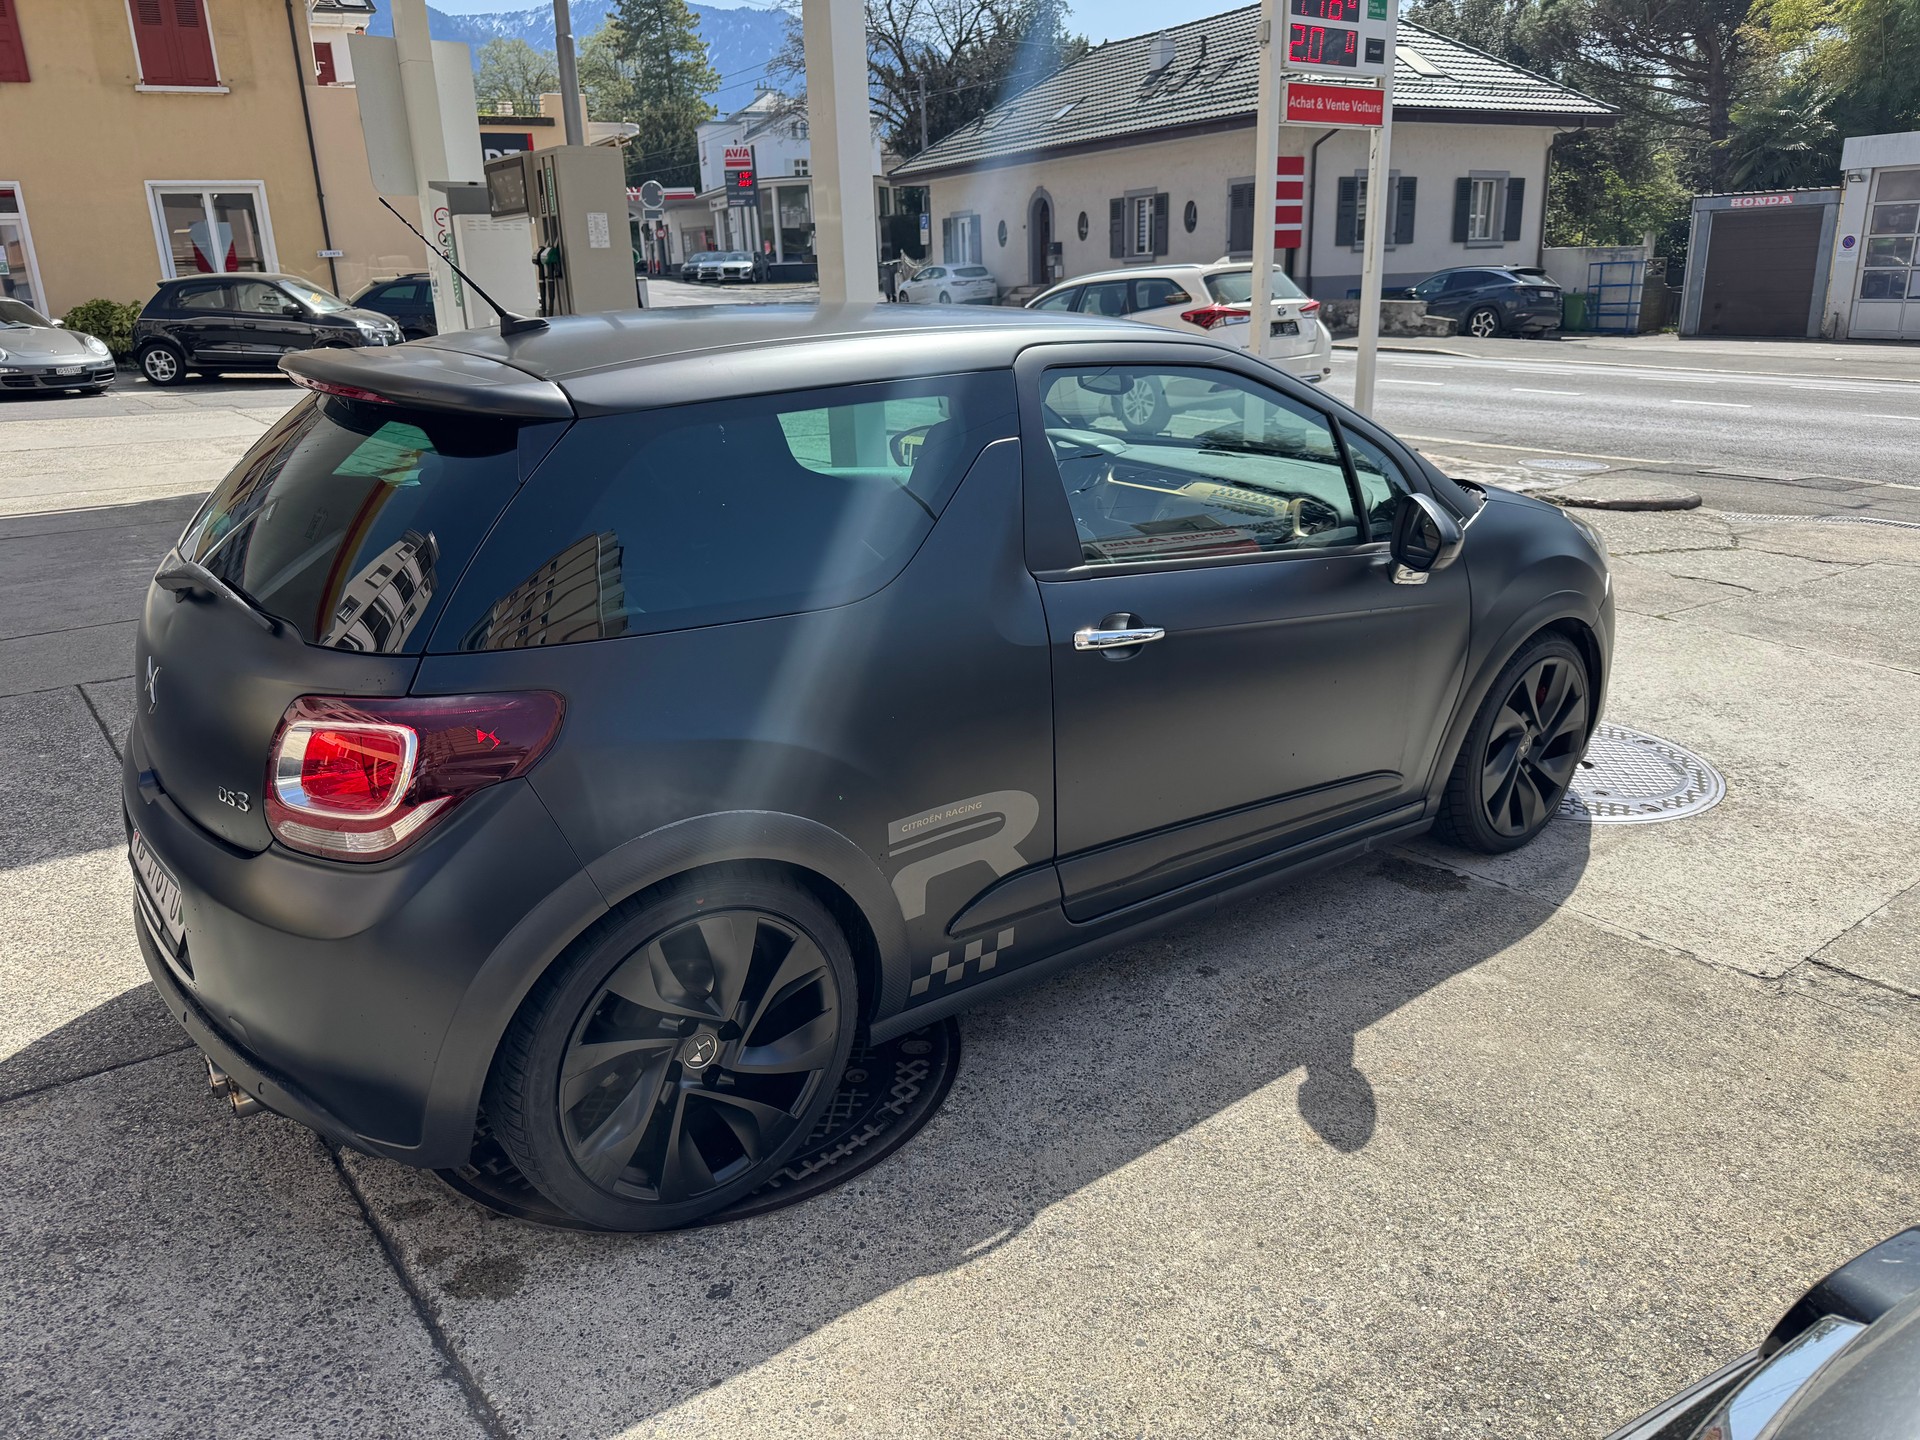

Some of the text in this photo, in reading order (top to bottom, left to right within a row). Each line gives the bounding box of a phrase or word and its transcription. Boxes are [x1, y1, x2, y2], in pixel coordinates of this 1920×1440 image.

[1289, 95, 1382, 113] Achat & Vente Voiture
[1730, 195, 1793, 207] HONDA
[218, 785, 250, 812] DS3
[901, 801, 983, 833] CITROËN RACING
